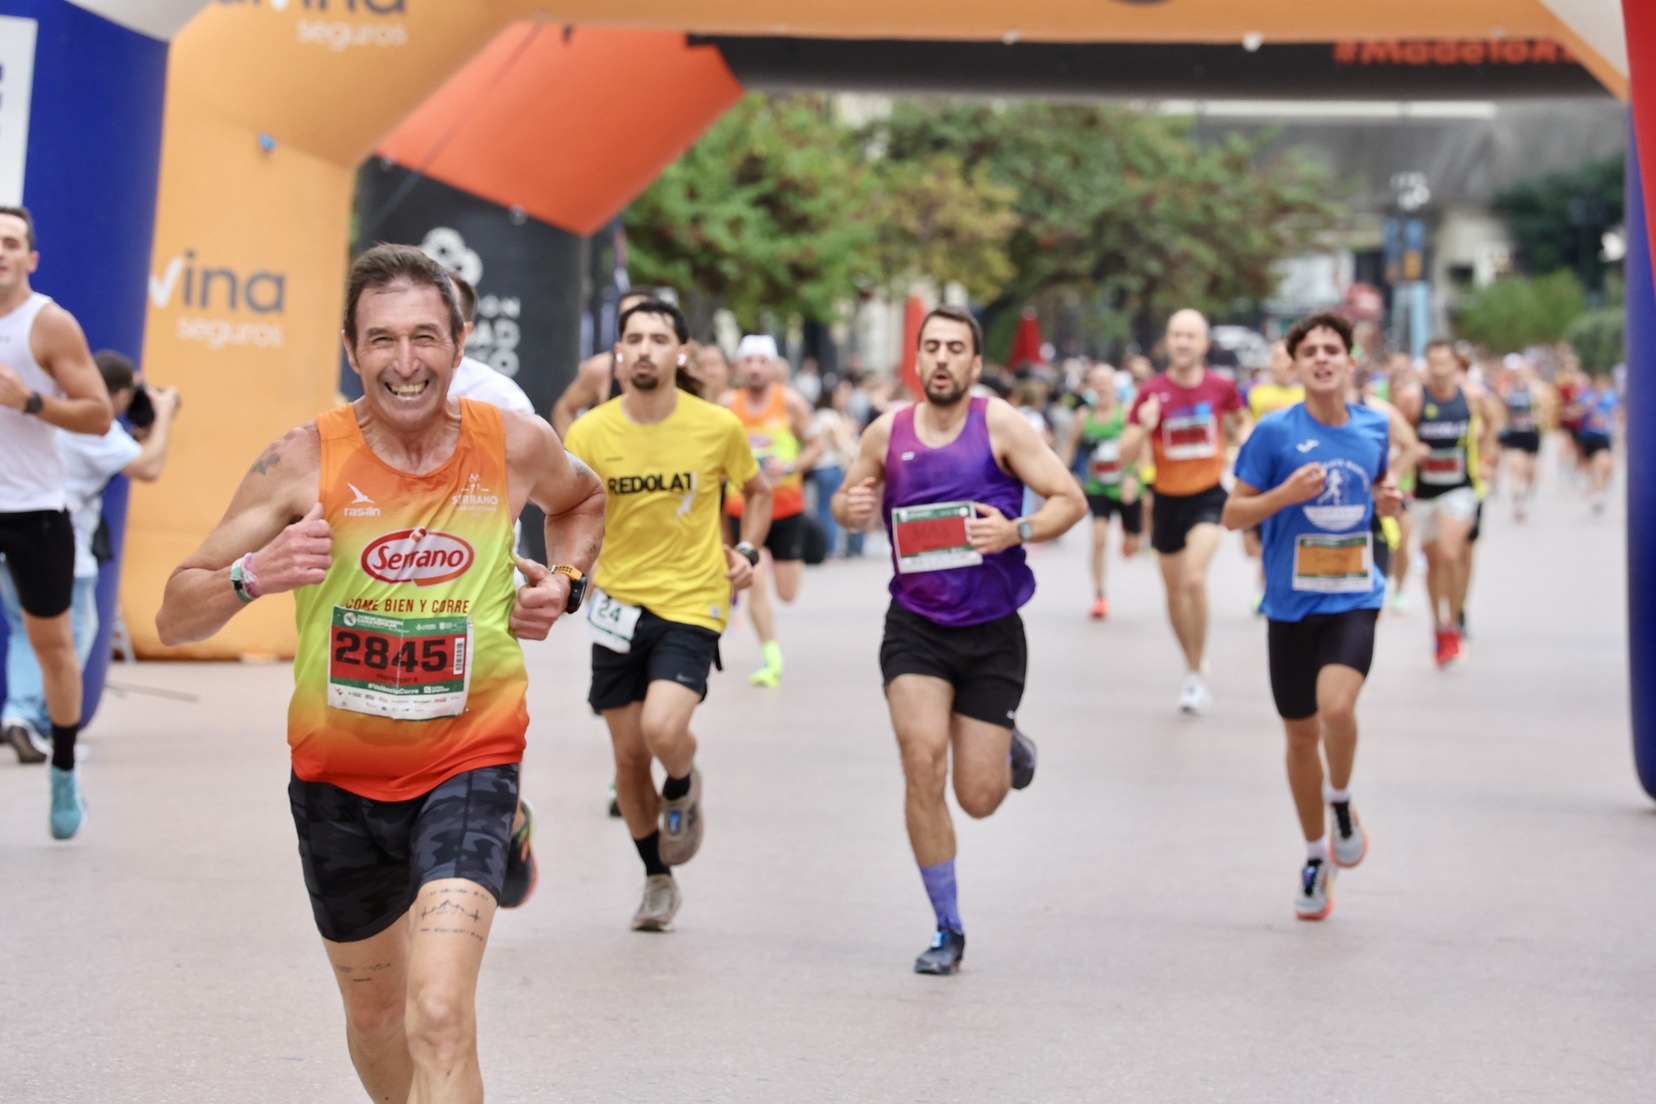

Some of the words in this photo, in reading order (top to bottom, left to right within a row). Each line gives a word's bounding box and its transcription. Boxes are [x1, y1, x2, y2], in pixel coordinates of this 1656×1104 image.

[296, 20, 408, 51] seguros
[176, 317, 285, 350] seguros
[451, 494, 499, 505] SERRANO
[372, 545, 464, 571] Serrano
[345, 598, 379, 611] COME
[384, 598, 414, 612] BIEN
[419, 599, 428, 612] Y
[335, 631, 448, 673] 2845
